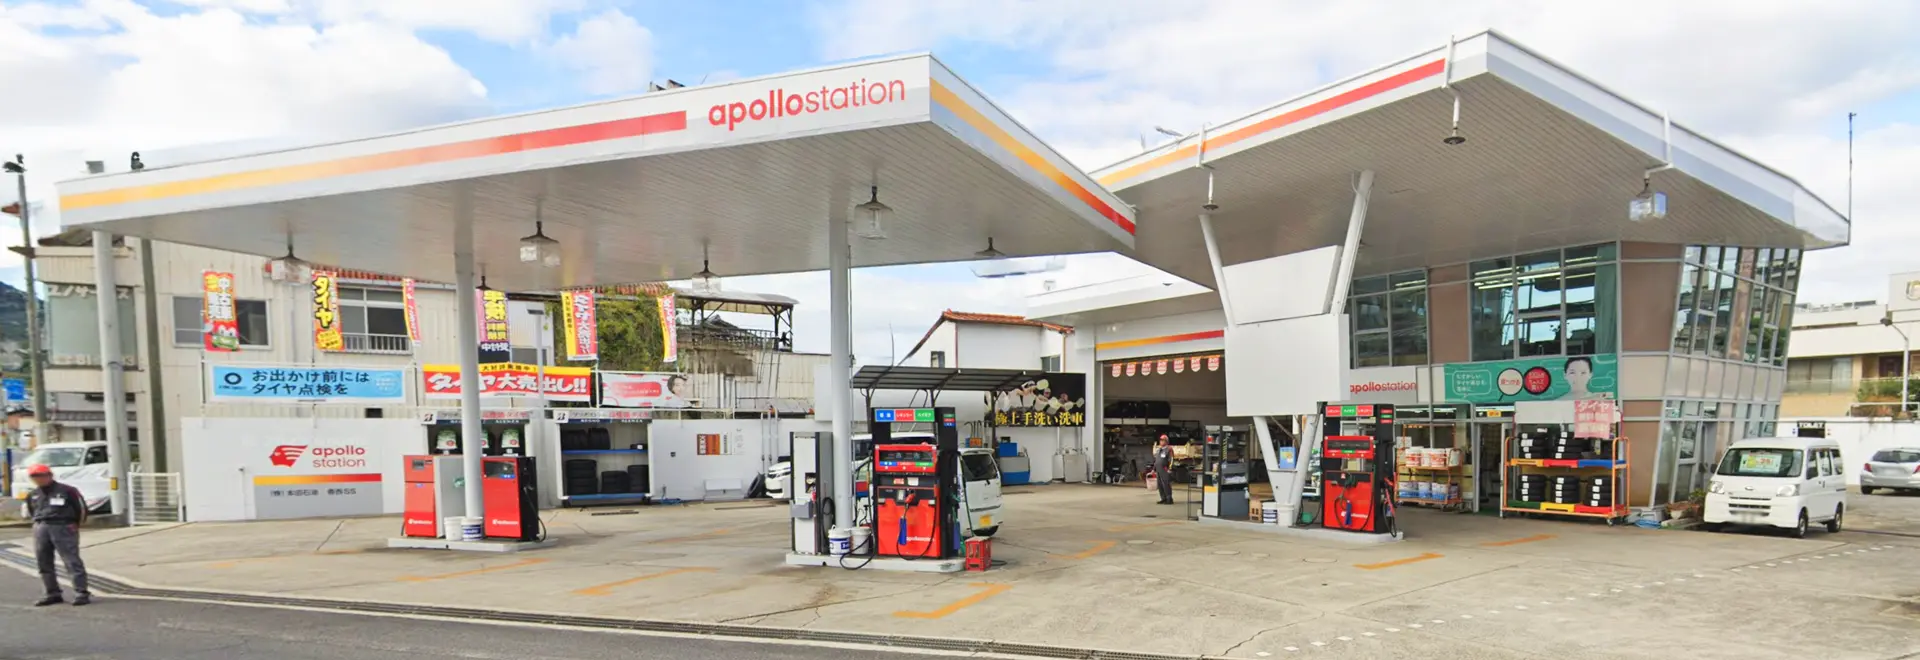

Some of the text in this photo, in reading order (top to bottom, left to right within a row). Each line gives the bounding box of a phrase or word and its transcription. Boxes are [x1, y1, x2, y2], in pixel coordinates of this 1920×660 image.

[708, 78, 906, 131] apollostation
[312, 276, 333, 328] タイヤ
[252, 370, 370, 383] お出かけ前には
[252, 383, 348, 395] タイヤ点検を
[995, 410, 1084, 425] 極上手洗い洗車
[312, 445, 365, 458] apollo
[312, 457, 366, 468] station
